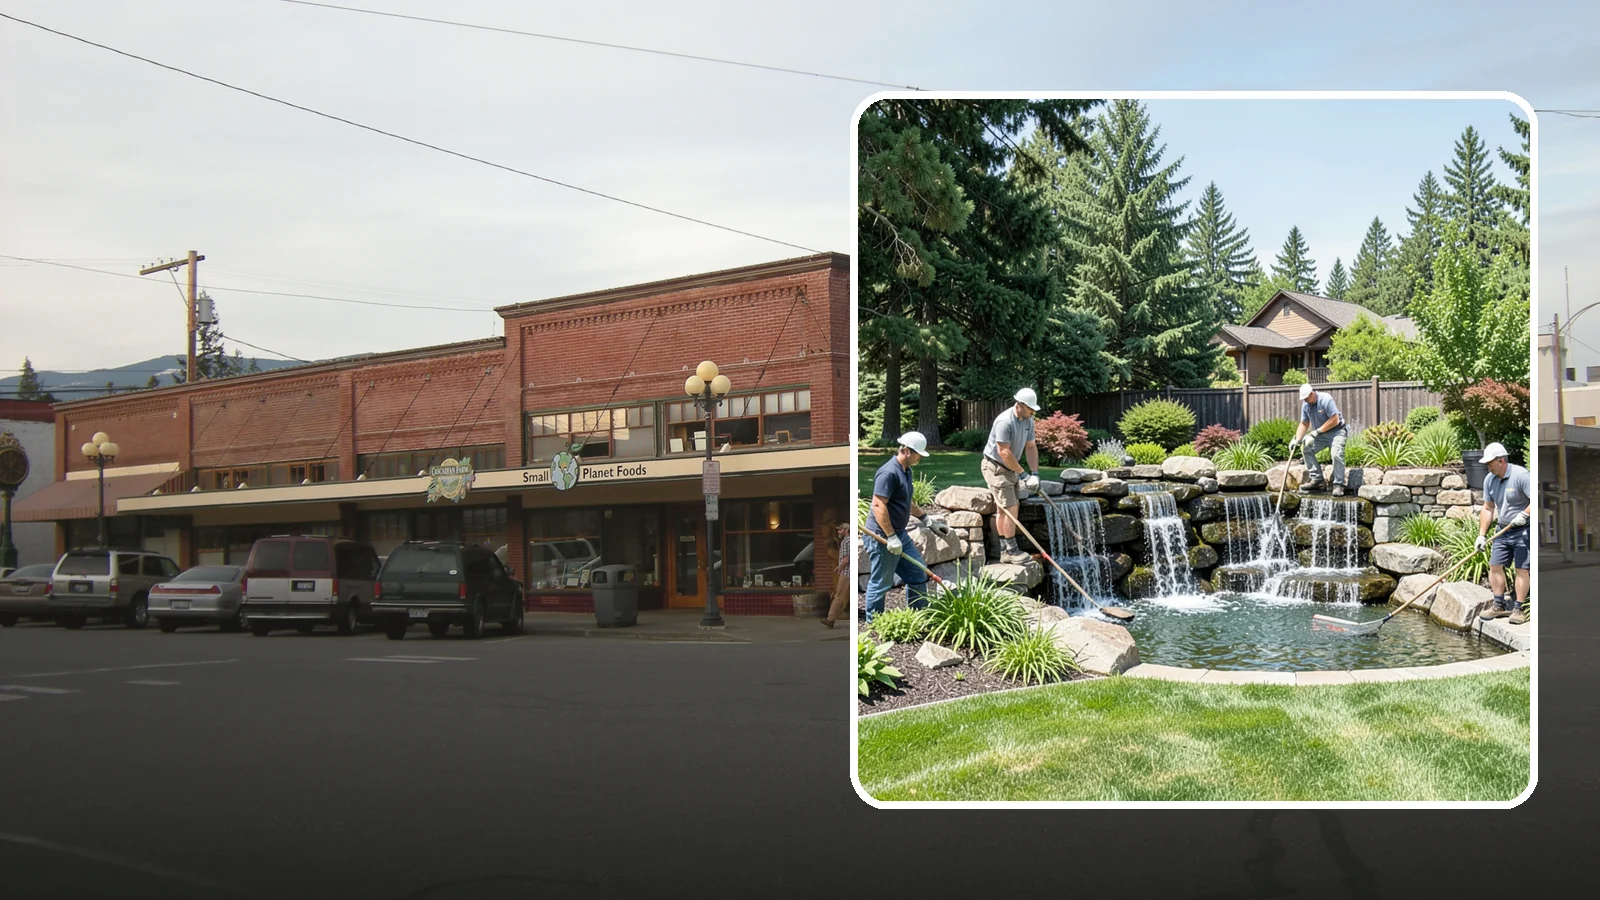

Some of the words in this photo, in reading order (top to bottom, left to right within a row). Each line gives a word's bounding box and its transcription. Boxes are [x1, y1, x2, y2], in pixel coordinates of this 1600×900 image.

[523, 471, 549, 483] Small
[583, 467, 614, 479] Planet
[617, 464, 647, 477] Foods
